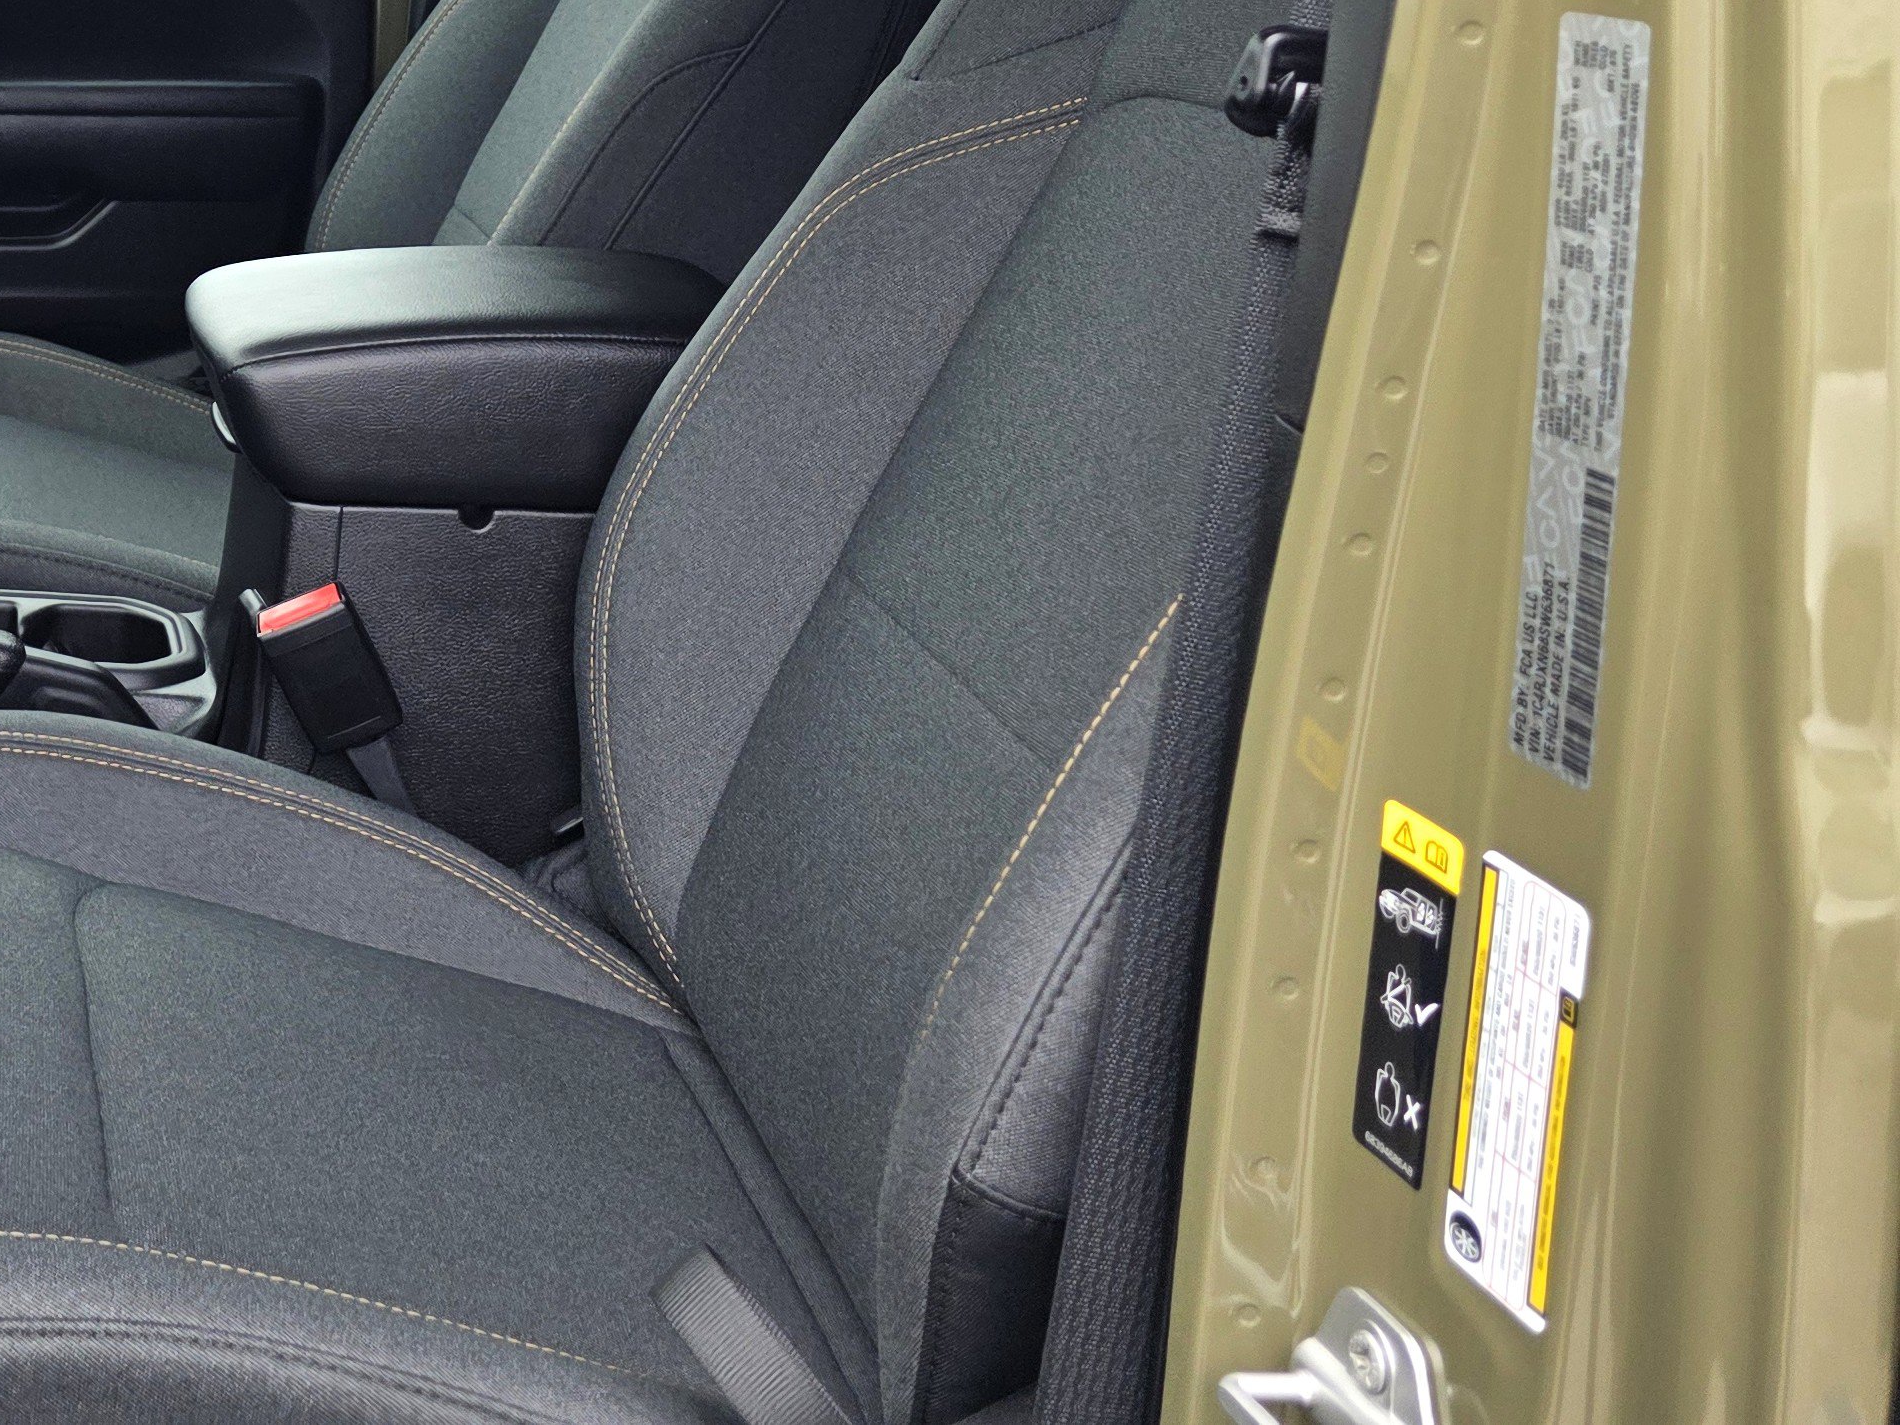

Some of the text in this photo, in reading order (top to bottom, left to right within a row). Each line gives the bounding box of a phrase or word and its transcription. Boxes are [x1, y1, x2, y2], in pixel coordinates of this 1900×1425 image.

[1524, 589, 1537, 619] LLC
[1523, 621, 1535, 644] US
[1520, 647, 1533, 677] FCA
[1549, 651, 1562, 697] MADE
[1513, 710, 1526, 747] MFD
[1543, 698, 1558, 763] VEHICLE
